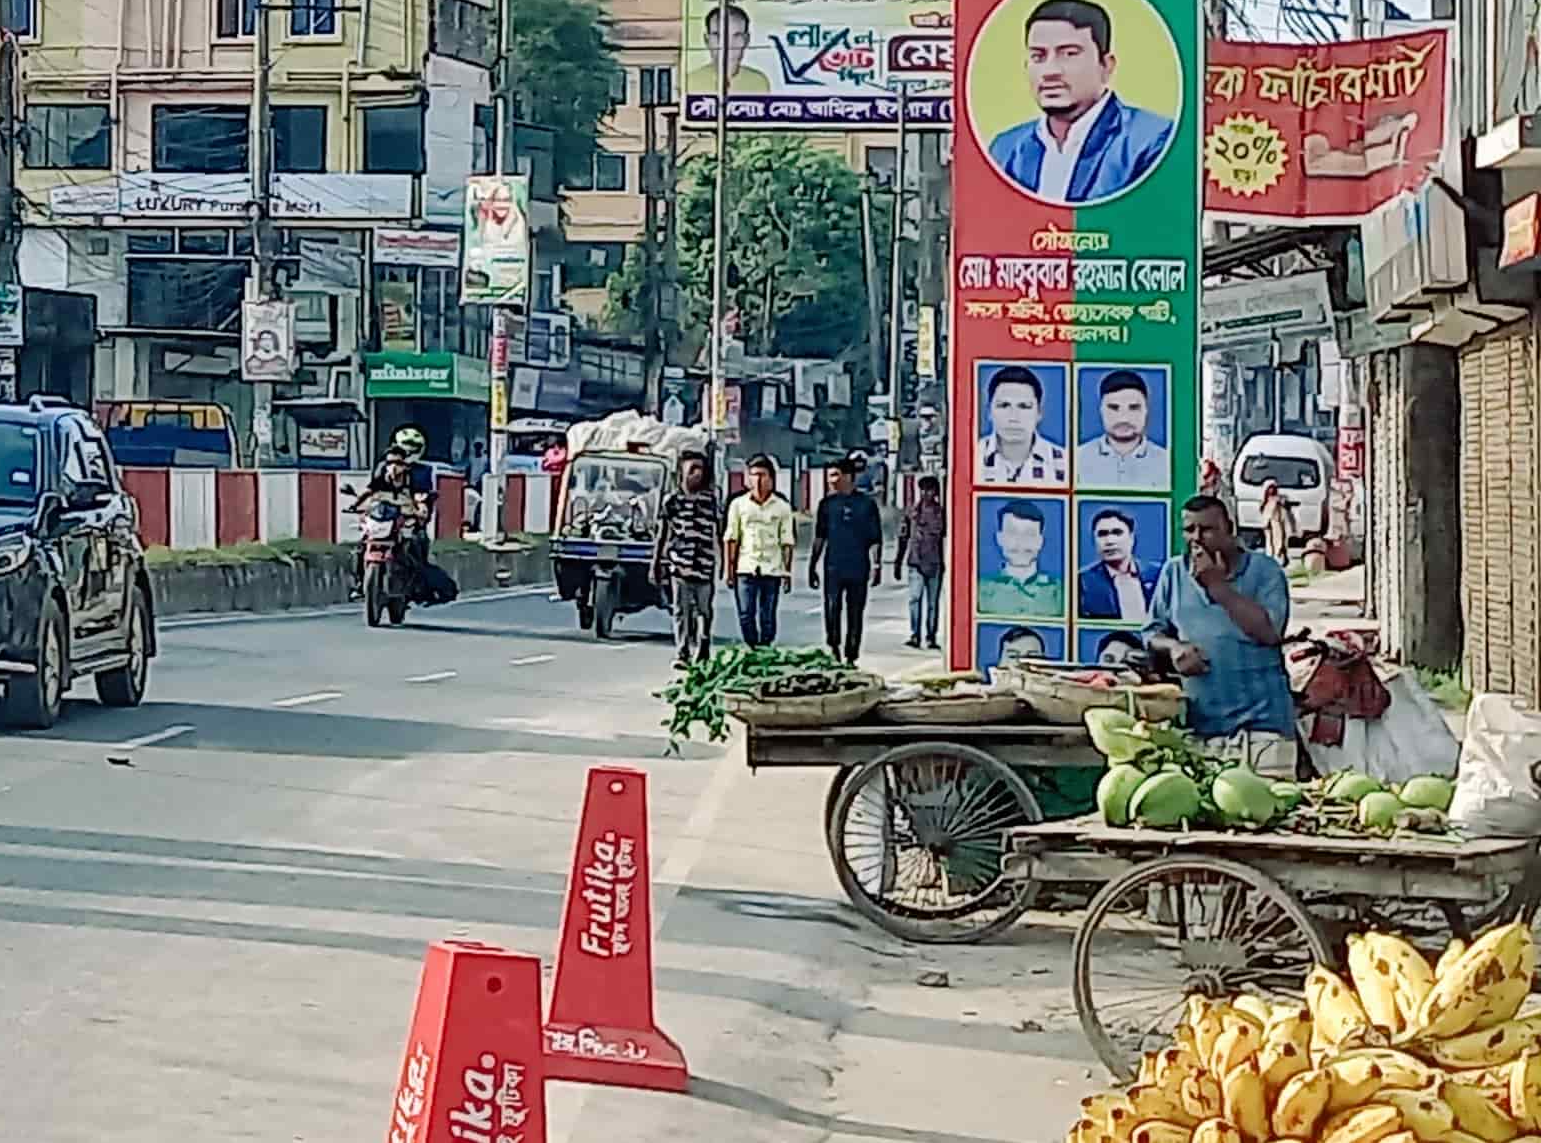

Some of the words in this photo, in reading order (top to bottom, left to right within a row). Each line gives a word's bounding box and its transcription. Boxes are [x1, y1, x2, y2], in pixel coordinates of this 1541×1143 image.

[1214, 136, 1278, 165] ২০%
[1072, 259, 1127, 293] রহমান
[1131, 259, 1187, 293] বেলাল
